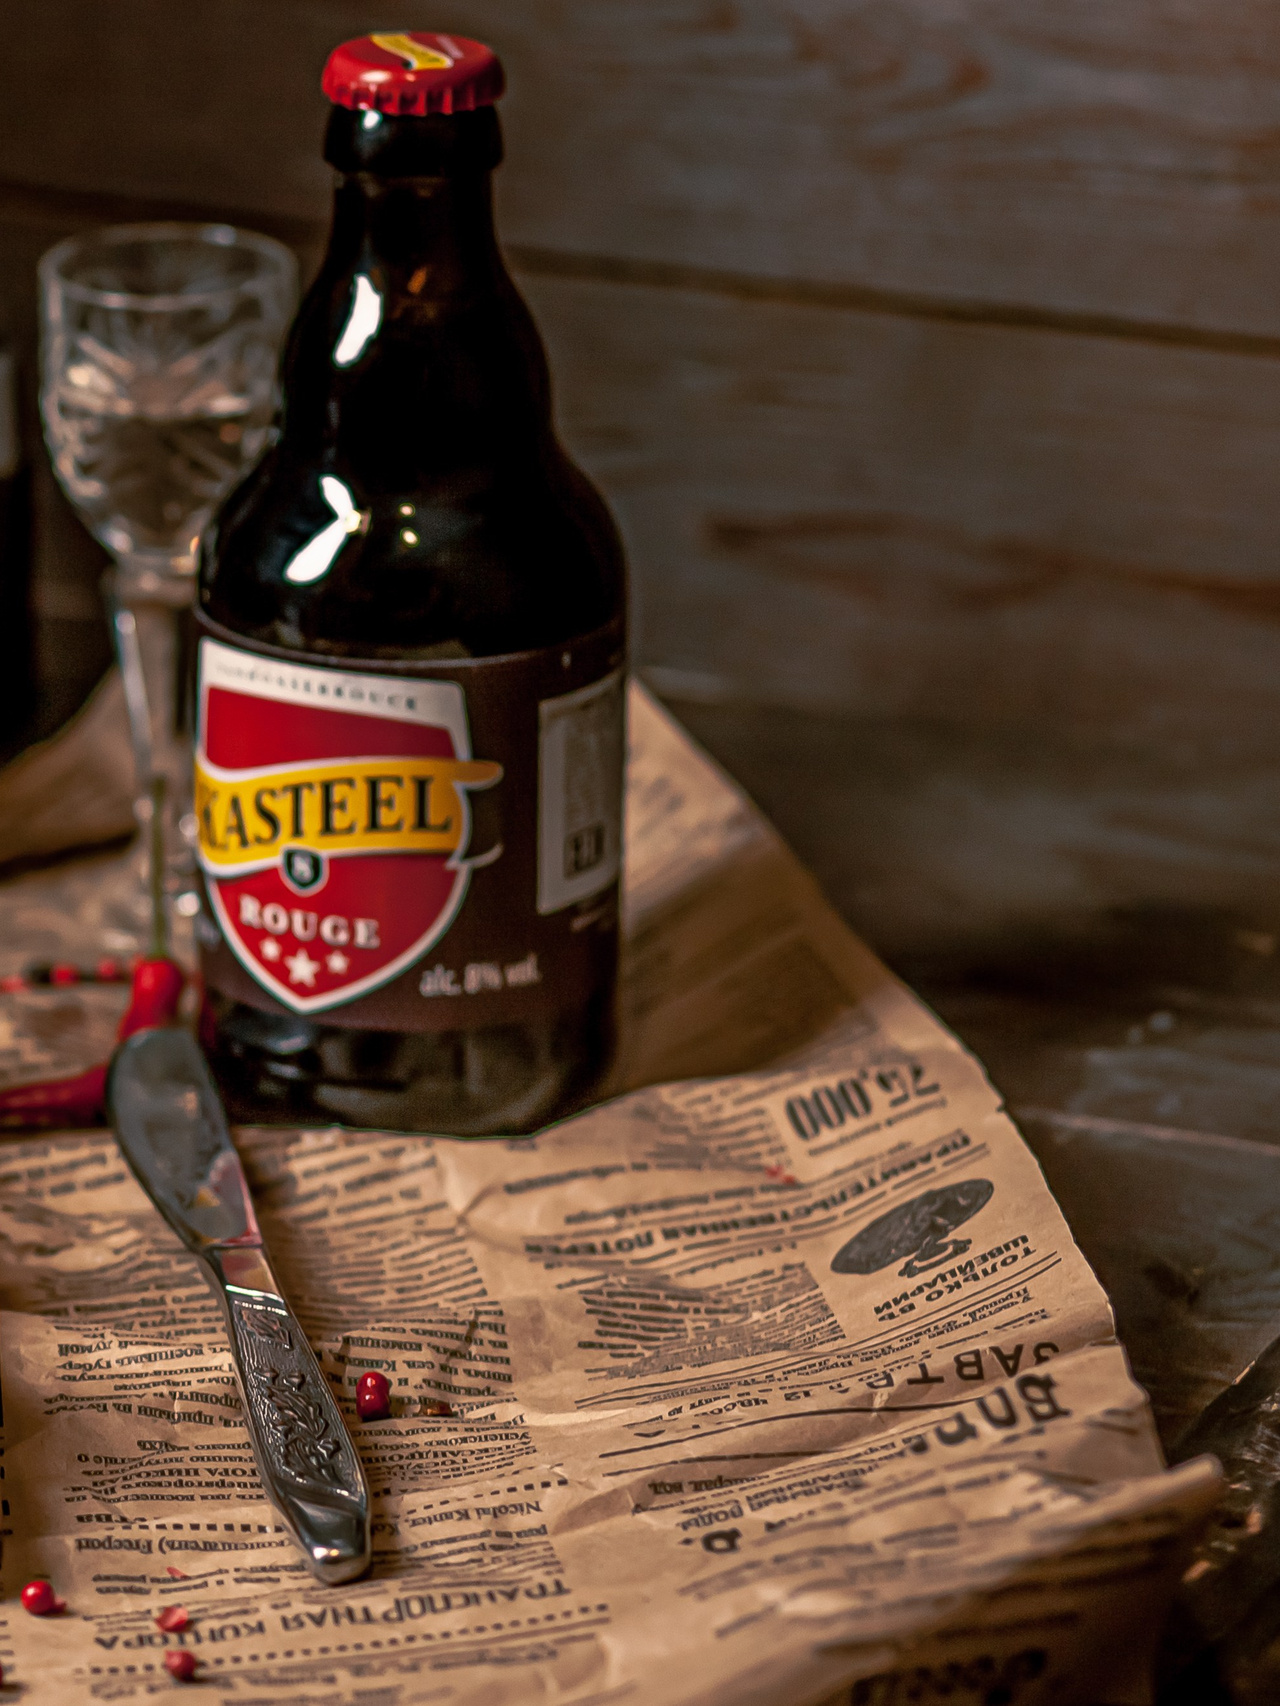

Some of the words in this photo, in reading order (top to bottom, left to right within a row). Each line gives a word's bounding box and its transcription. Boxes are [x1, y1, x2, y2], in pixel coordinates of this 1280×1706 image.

[238, 893, 381, 949] ROUGE
[873, 1235, 1029, 1315] ШВЕЙЦАРИИ
[925, 1246, 1036, 1302] ТОЛЬКО
[878, 1302, 916, 1322] ВЪ
[474, 1500, 543, 1519] Nicolai
[74, 1536, 153, 1555] Freeport
